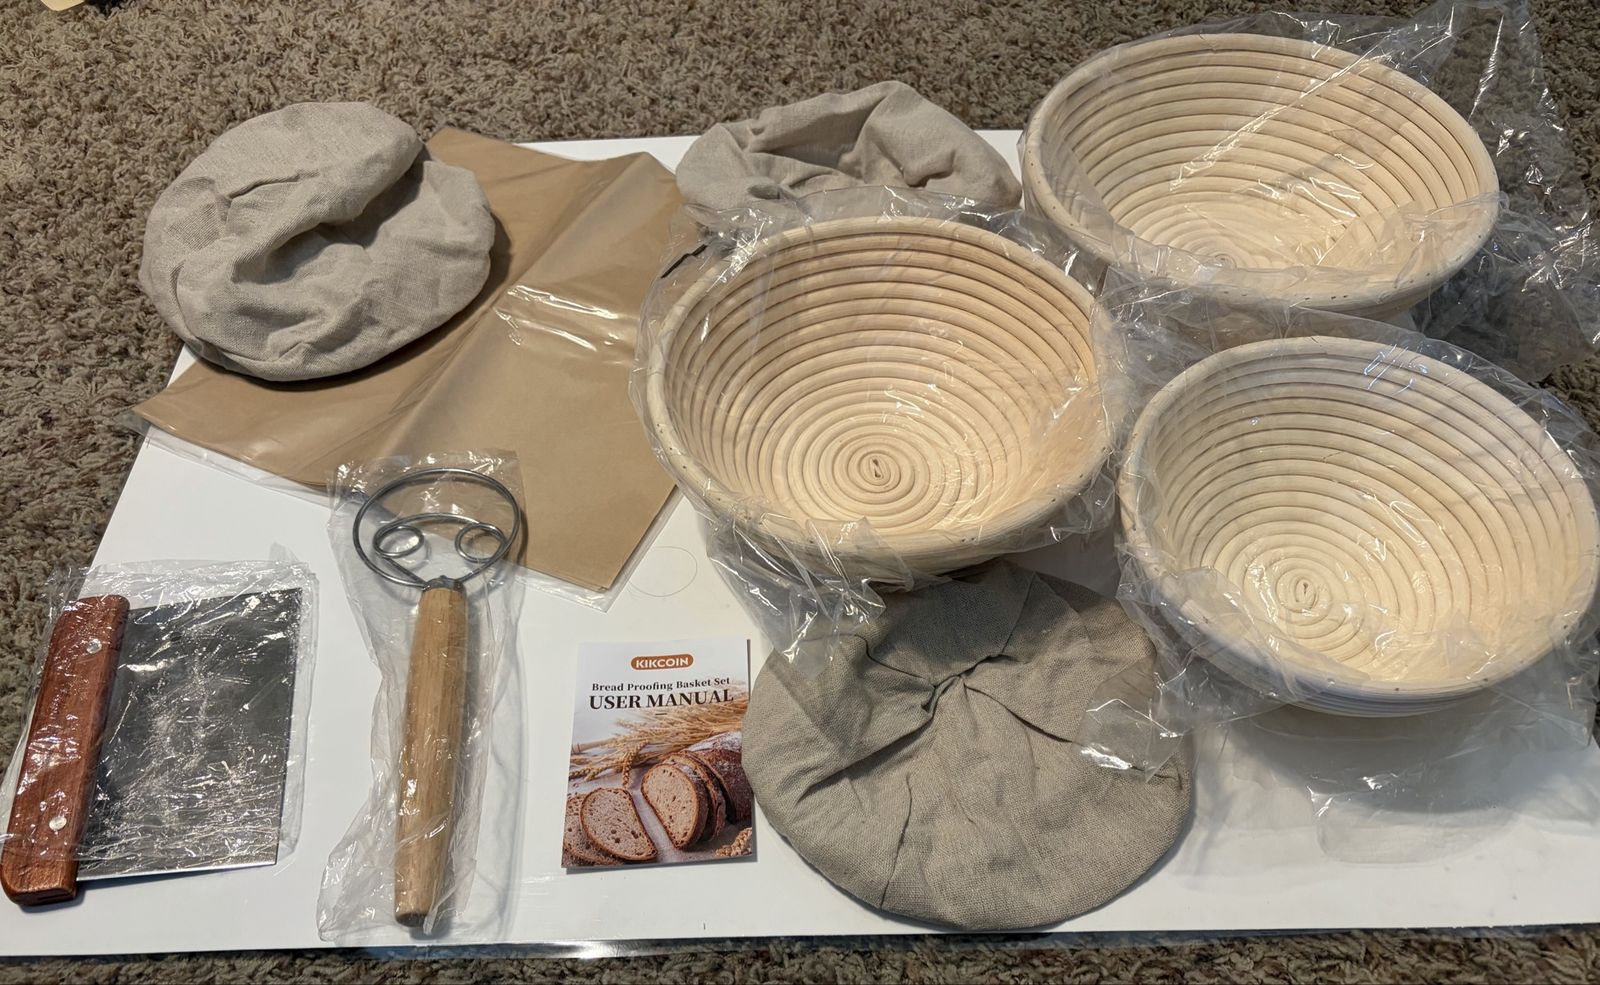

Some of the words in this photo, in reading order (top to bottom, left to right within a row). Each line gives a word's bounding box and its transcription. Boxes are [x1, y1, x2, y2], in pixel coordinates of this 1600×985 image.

[635, 657, 689, 669] KIKCOIN
[592, 683, 624, 691] Bread
[627, 681, 673, 691] Proofing
[676, 679, 711, 689] Basket
[714, 676, 730, 685] Set
[589, 694, 641, 710] USER
[646, 689, 734, 708] MANUAL
